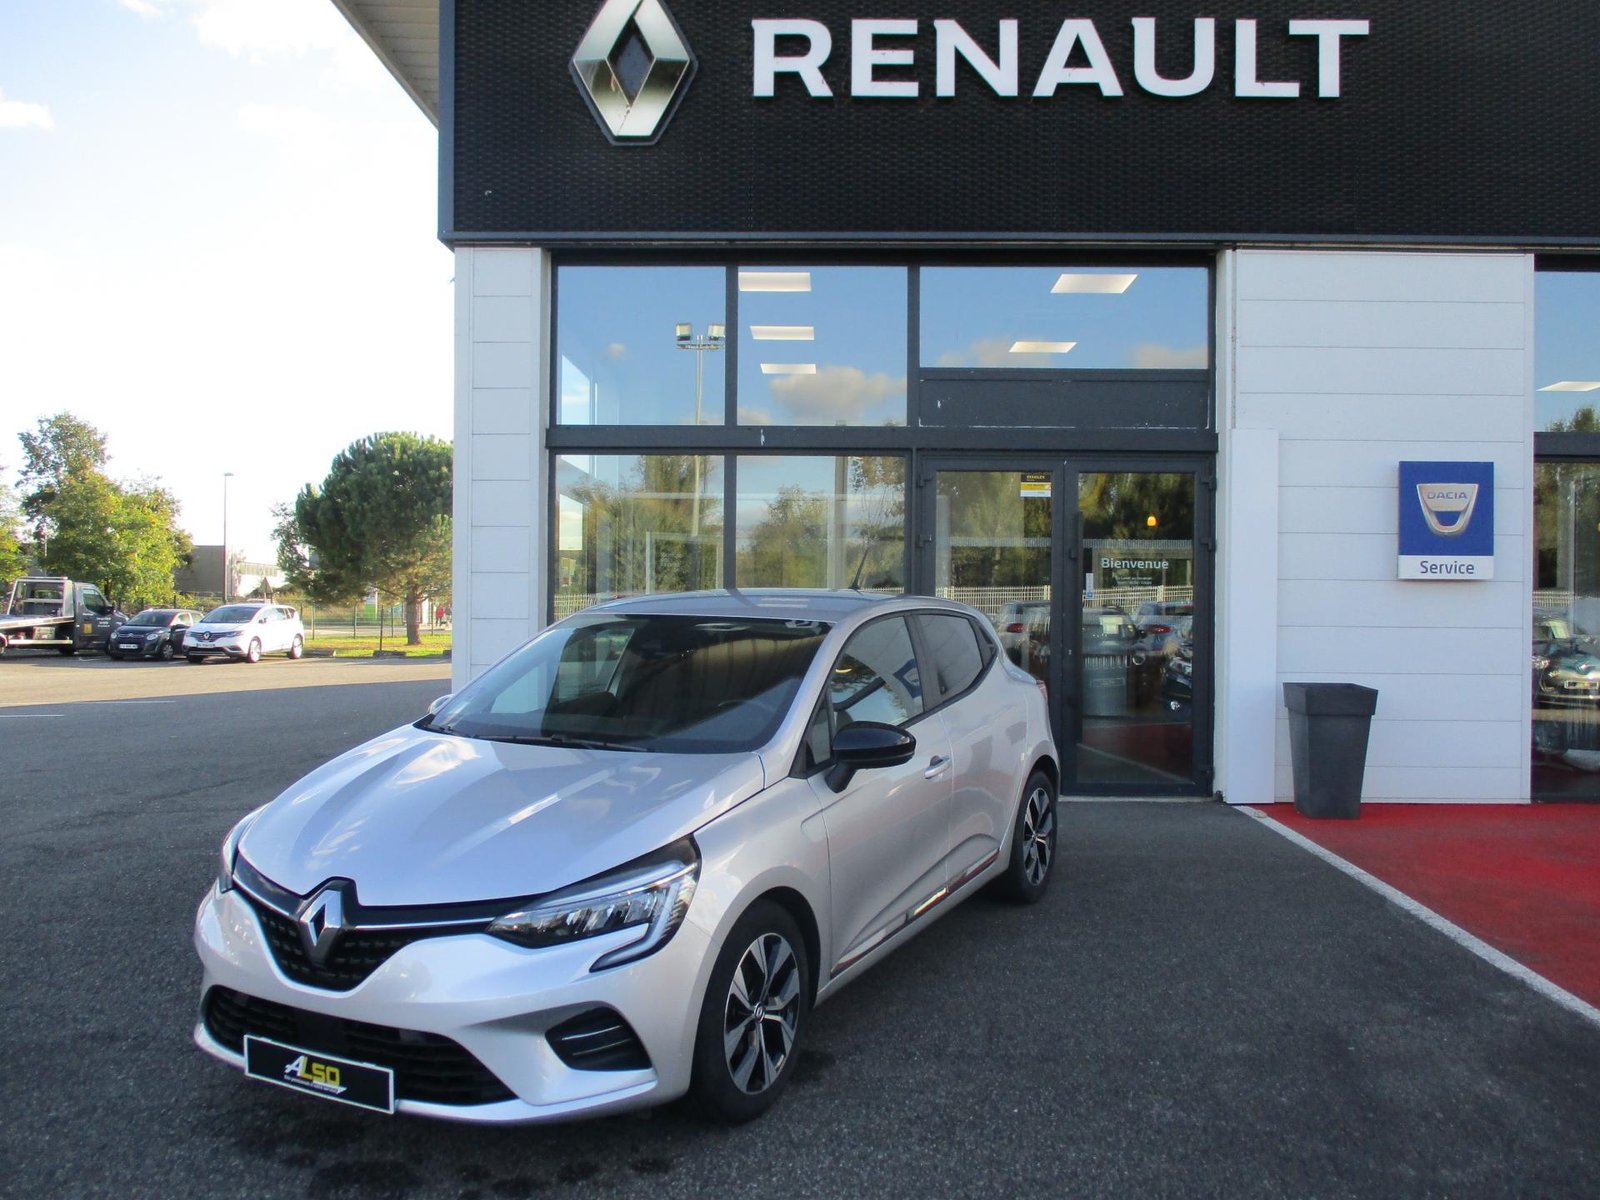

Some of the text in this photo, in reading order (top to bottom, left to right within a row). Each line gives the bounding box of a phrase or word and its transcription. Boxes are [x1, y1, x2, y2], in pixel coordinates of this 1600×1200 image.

[751, 17, 1370, 97] RENAULT
[1427, 491, 1467, 500] DACIA
[1101, 557, 1169, 569] Bienvenue
[1420, 560, 1475, 575] Service
[284, 1055, 340, 1086] ALSO
